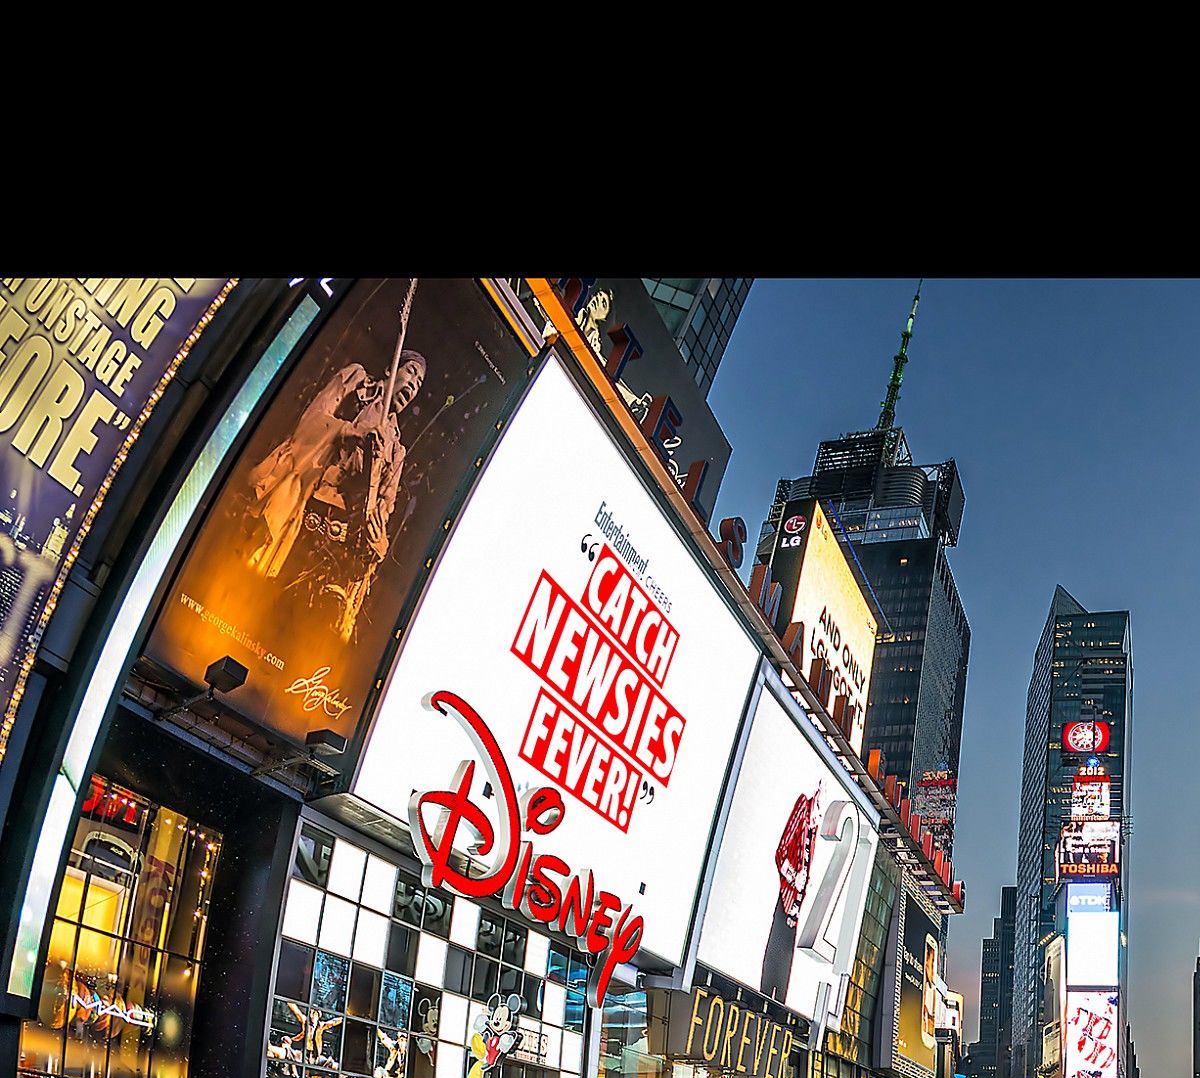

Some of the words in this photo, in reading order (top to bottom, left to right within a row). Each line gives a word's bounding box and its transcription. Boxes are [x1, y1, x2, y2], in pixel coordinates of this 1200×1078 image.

[594, 500, 650, 575] Entertainment
[780, 536, 802, 549] LG
[180, 592, 285, 671] www.georgekalinsky.com
[818, 605, 841, 651] AND
[842, 643, 866, 694] ONLY
[514, 575, 685, 781] NEWSIES
[1079, 767, 1105, 776] 2012
[1087, 805, 1094, 814] 5
[1060, 863, 1119, 874] TOSHIBA
[1079, 895, 1106, 906] TDK
